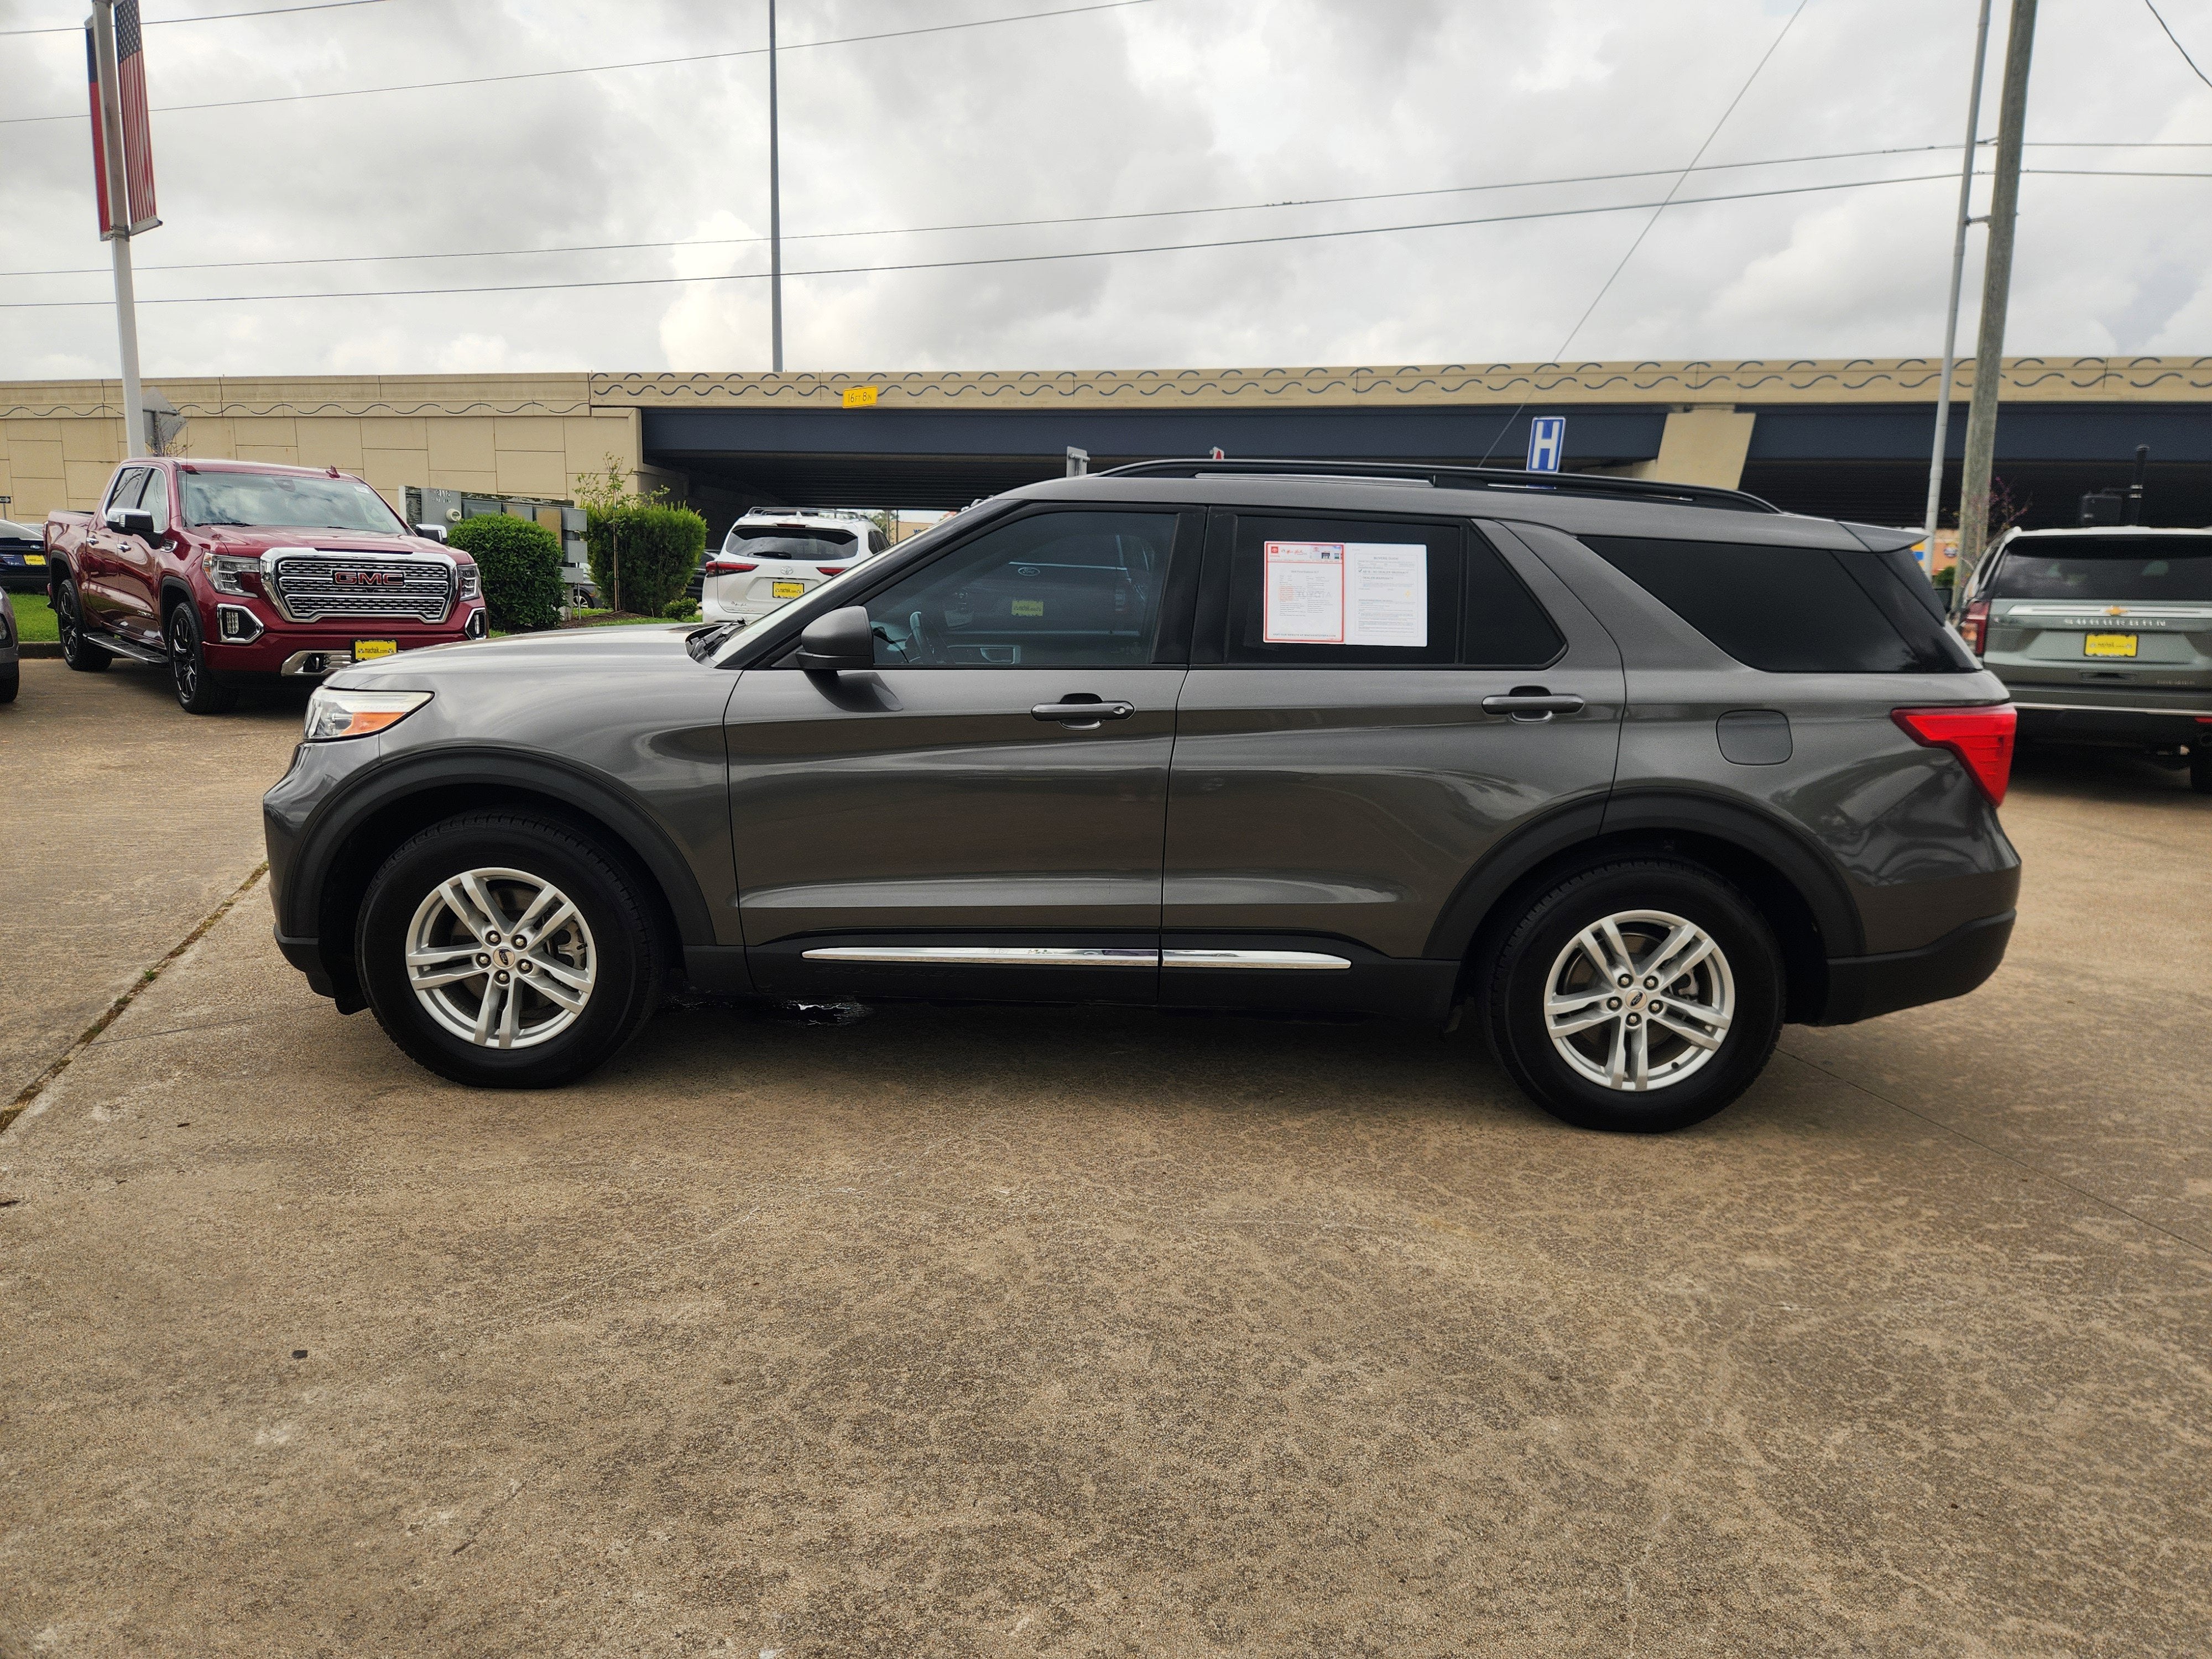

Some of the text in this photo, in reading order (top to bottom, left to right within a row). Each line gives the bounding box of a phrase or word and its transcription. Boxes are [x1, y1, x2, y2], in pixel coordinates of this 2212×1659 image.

[1531, 421, 1560, 469] H
[335, 572, 403, 585] GMC
[2064, 618, 2167, 627] SUBURBAN
